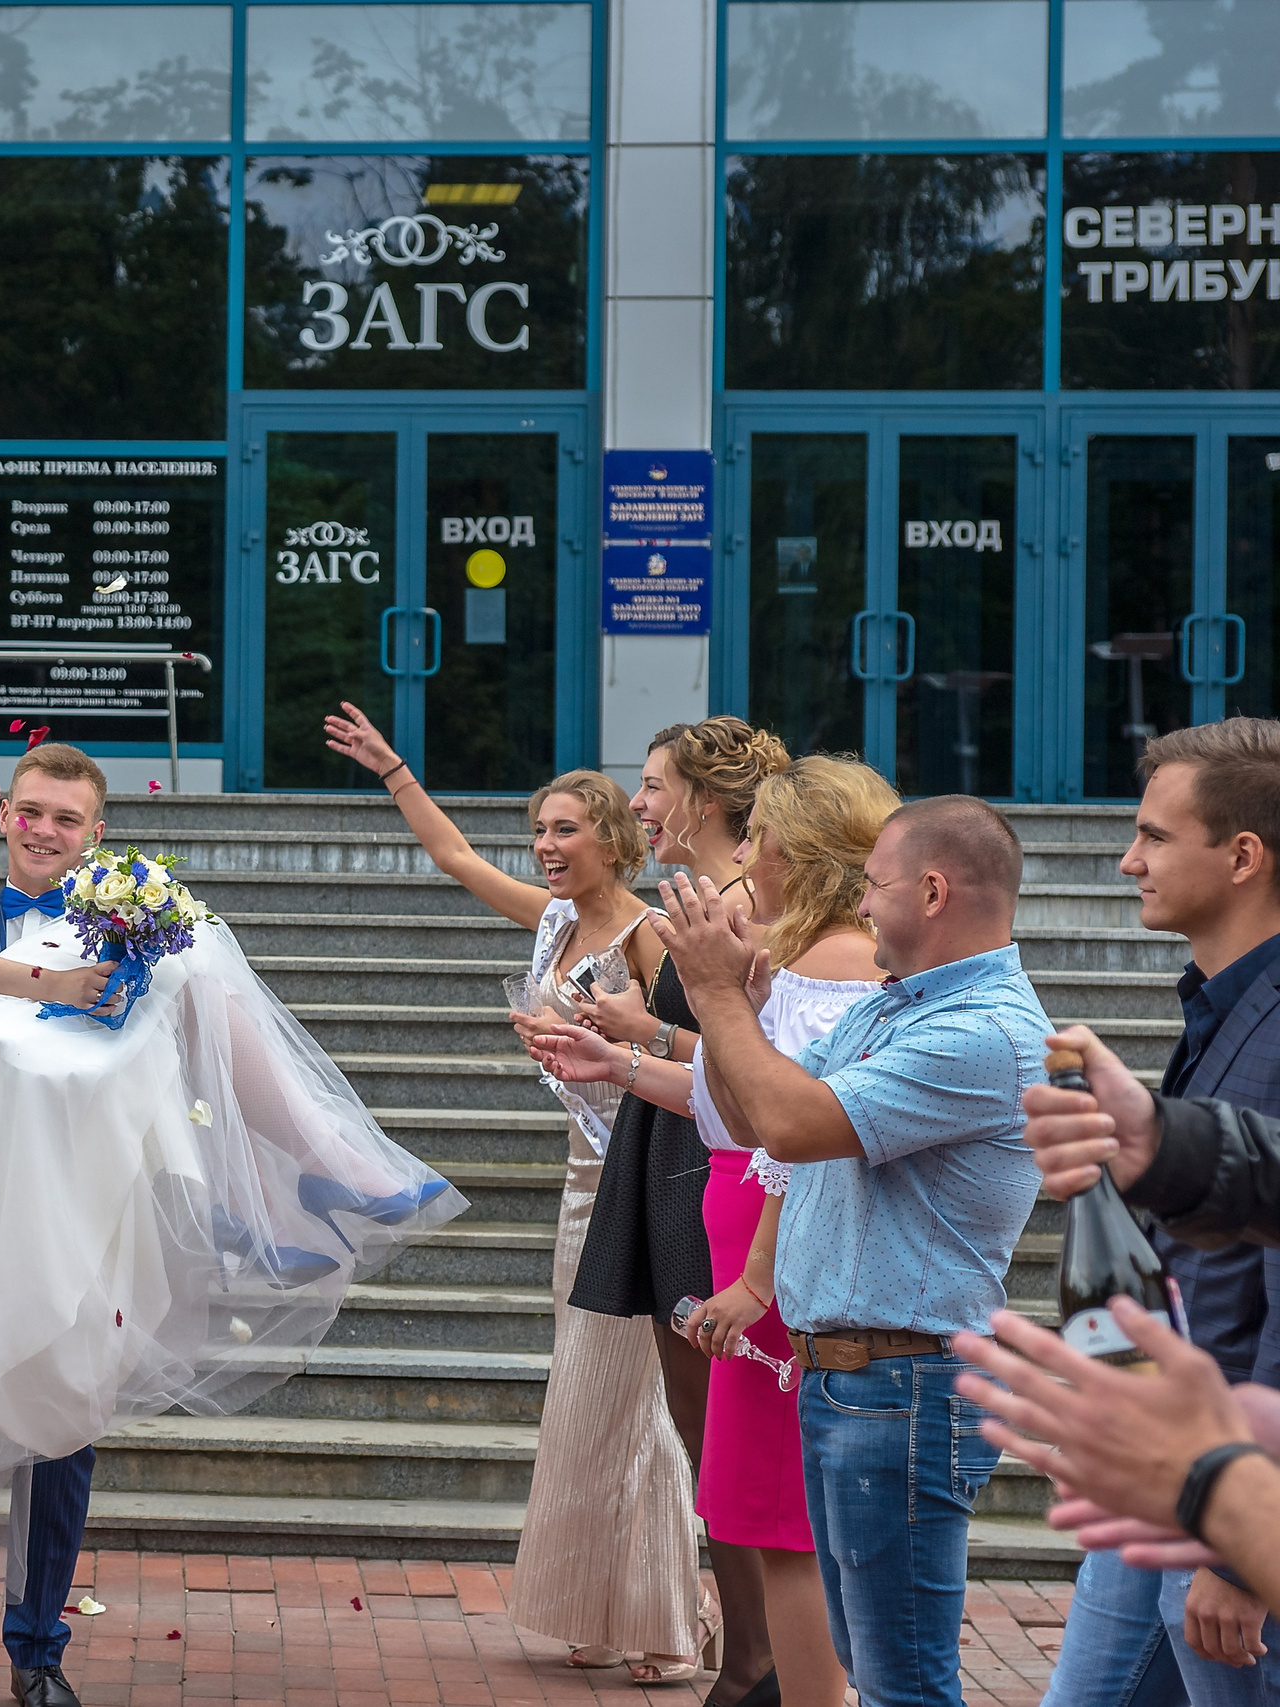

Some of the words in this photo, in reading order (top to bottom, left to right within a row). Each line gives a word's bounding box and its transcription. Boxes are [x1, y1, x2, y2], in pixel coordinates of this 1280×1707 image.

[1064, 204, 1280, 248] СЕВЕРН
[299, 281, 530, 352] ЗАГС
[43, 460, 112, 476] ПРИЕМА
[114, 460, 218, 477] НАСЕЛЕНИЯ:
[11, 500, 69, 516] Вторник
[93, 501, 170, 515] 09:00-17:00
[610, 511, 678, 522] УПРАВЛЕНИЕ
[680, 511, 705, 522] ЗАГС
[10, 520, 51, 536] Среда
[441, 516, 537, 547] ВХОД
[905, 520, 1003, 553] ВХОД
[11, 550, 65, 565] Четверг
[92, 550, 169, 564] 09:00-17:00
[276, 551, 380, 584] ЗАГС
[10, 570, 70, 584] Пятница
[10, 590, 63, 606] Суббота
[10, 615, 56, 628] ВТ-ПТ
[57, 617, 114, 630] перерыв
[117, 615, 192, 629] 13:00-14:00
[677, 612, 700, 622] ЗАГС
[50, 667, 127, 681] 09:00-13:00
